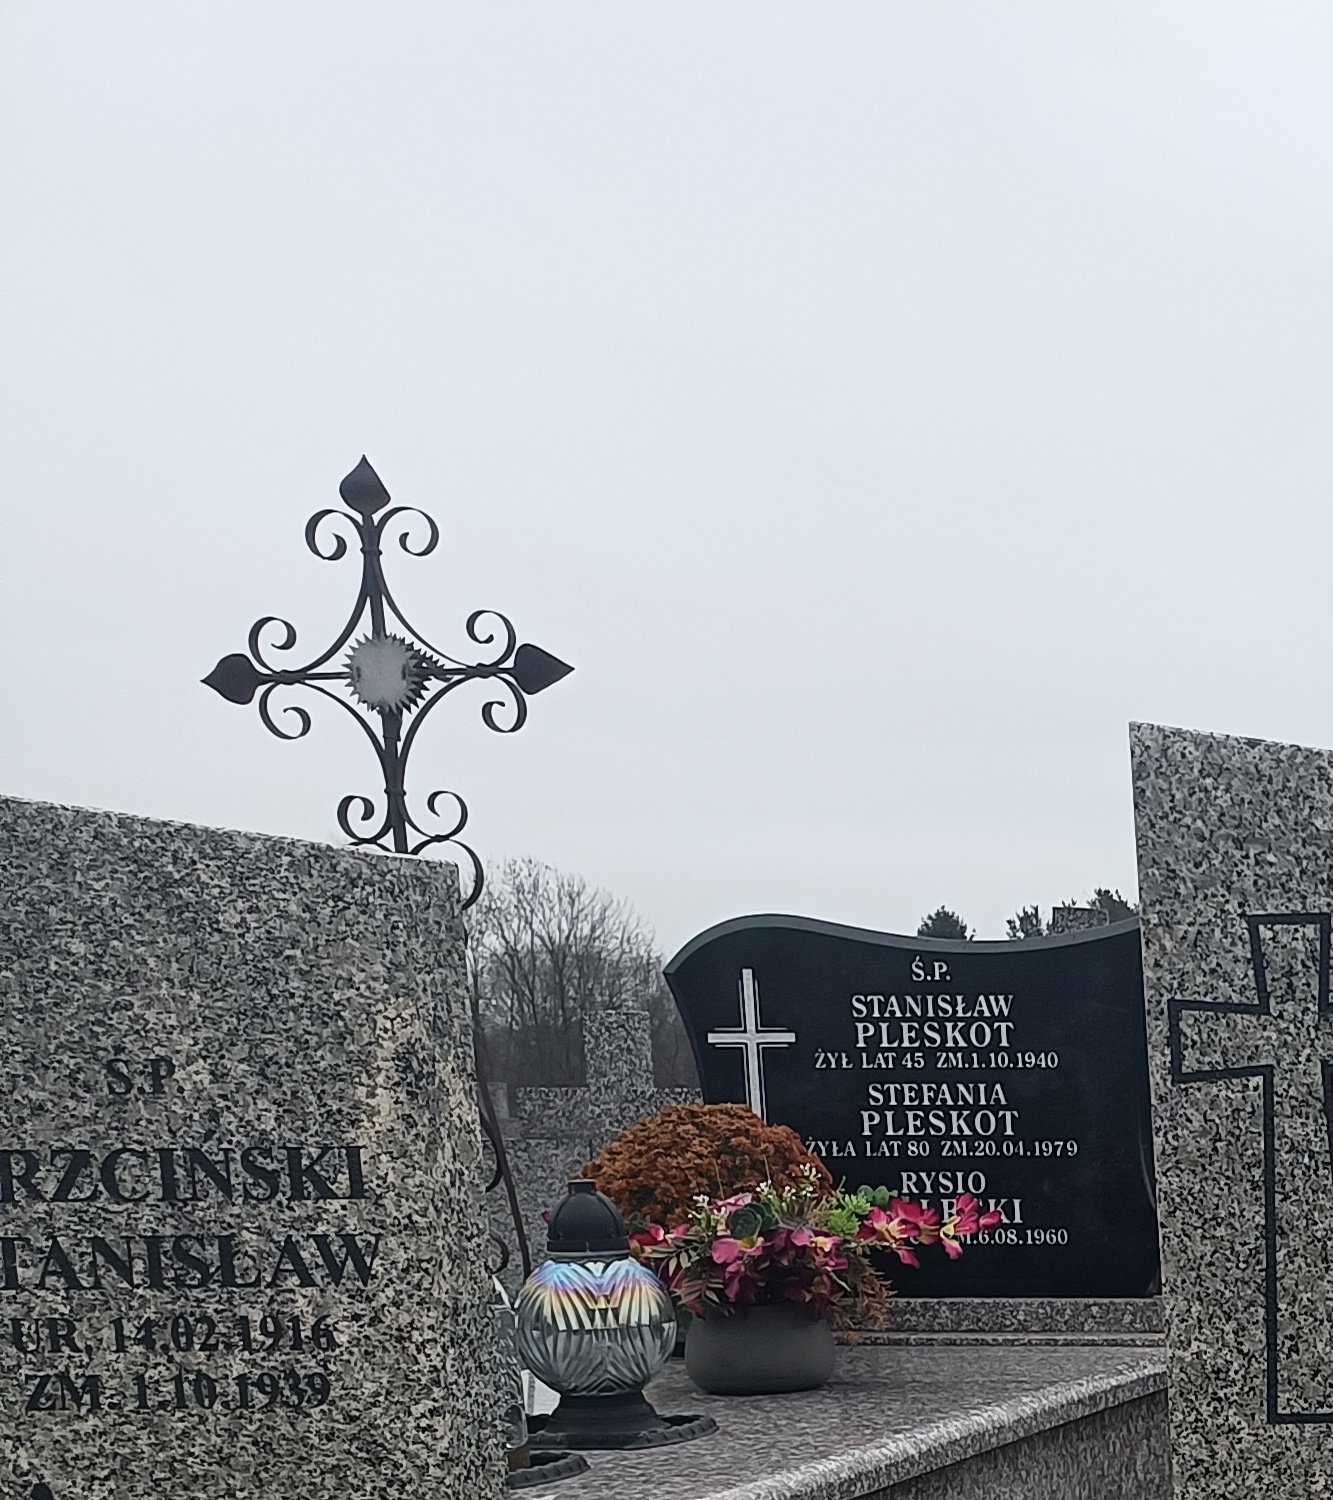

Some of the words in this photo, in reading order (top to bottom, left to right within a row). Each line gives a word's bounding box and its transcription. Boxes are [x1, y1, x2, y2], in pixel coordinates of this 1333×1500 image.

[912, 956, 951, 981] Ś.P.
[852, 994, 1014, 1019] STANISŁAW
[855, 1022, 1015, 1048] PLESKOT
[815, 1048, 853, 1069] ŻYŁ
[861, 1052, 897, 1069] LAT
[901, 1052, 925, 1069] 45
[868, 1083, 1008, 1106] STEFANIA
[861, 1110, 1019, 1136] PLESKOT
[805, 1136, 857, 1157] ŻYŁA
[865, 1140, 901, 1157] LAT
[907, 1140, 930, 1157] 80
[901, 1171, 986, 1194] RYSIO
